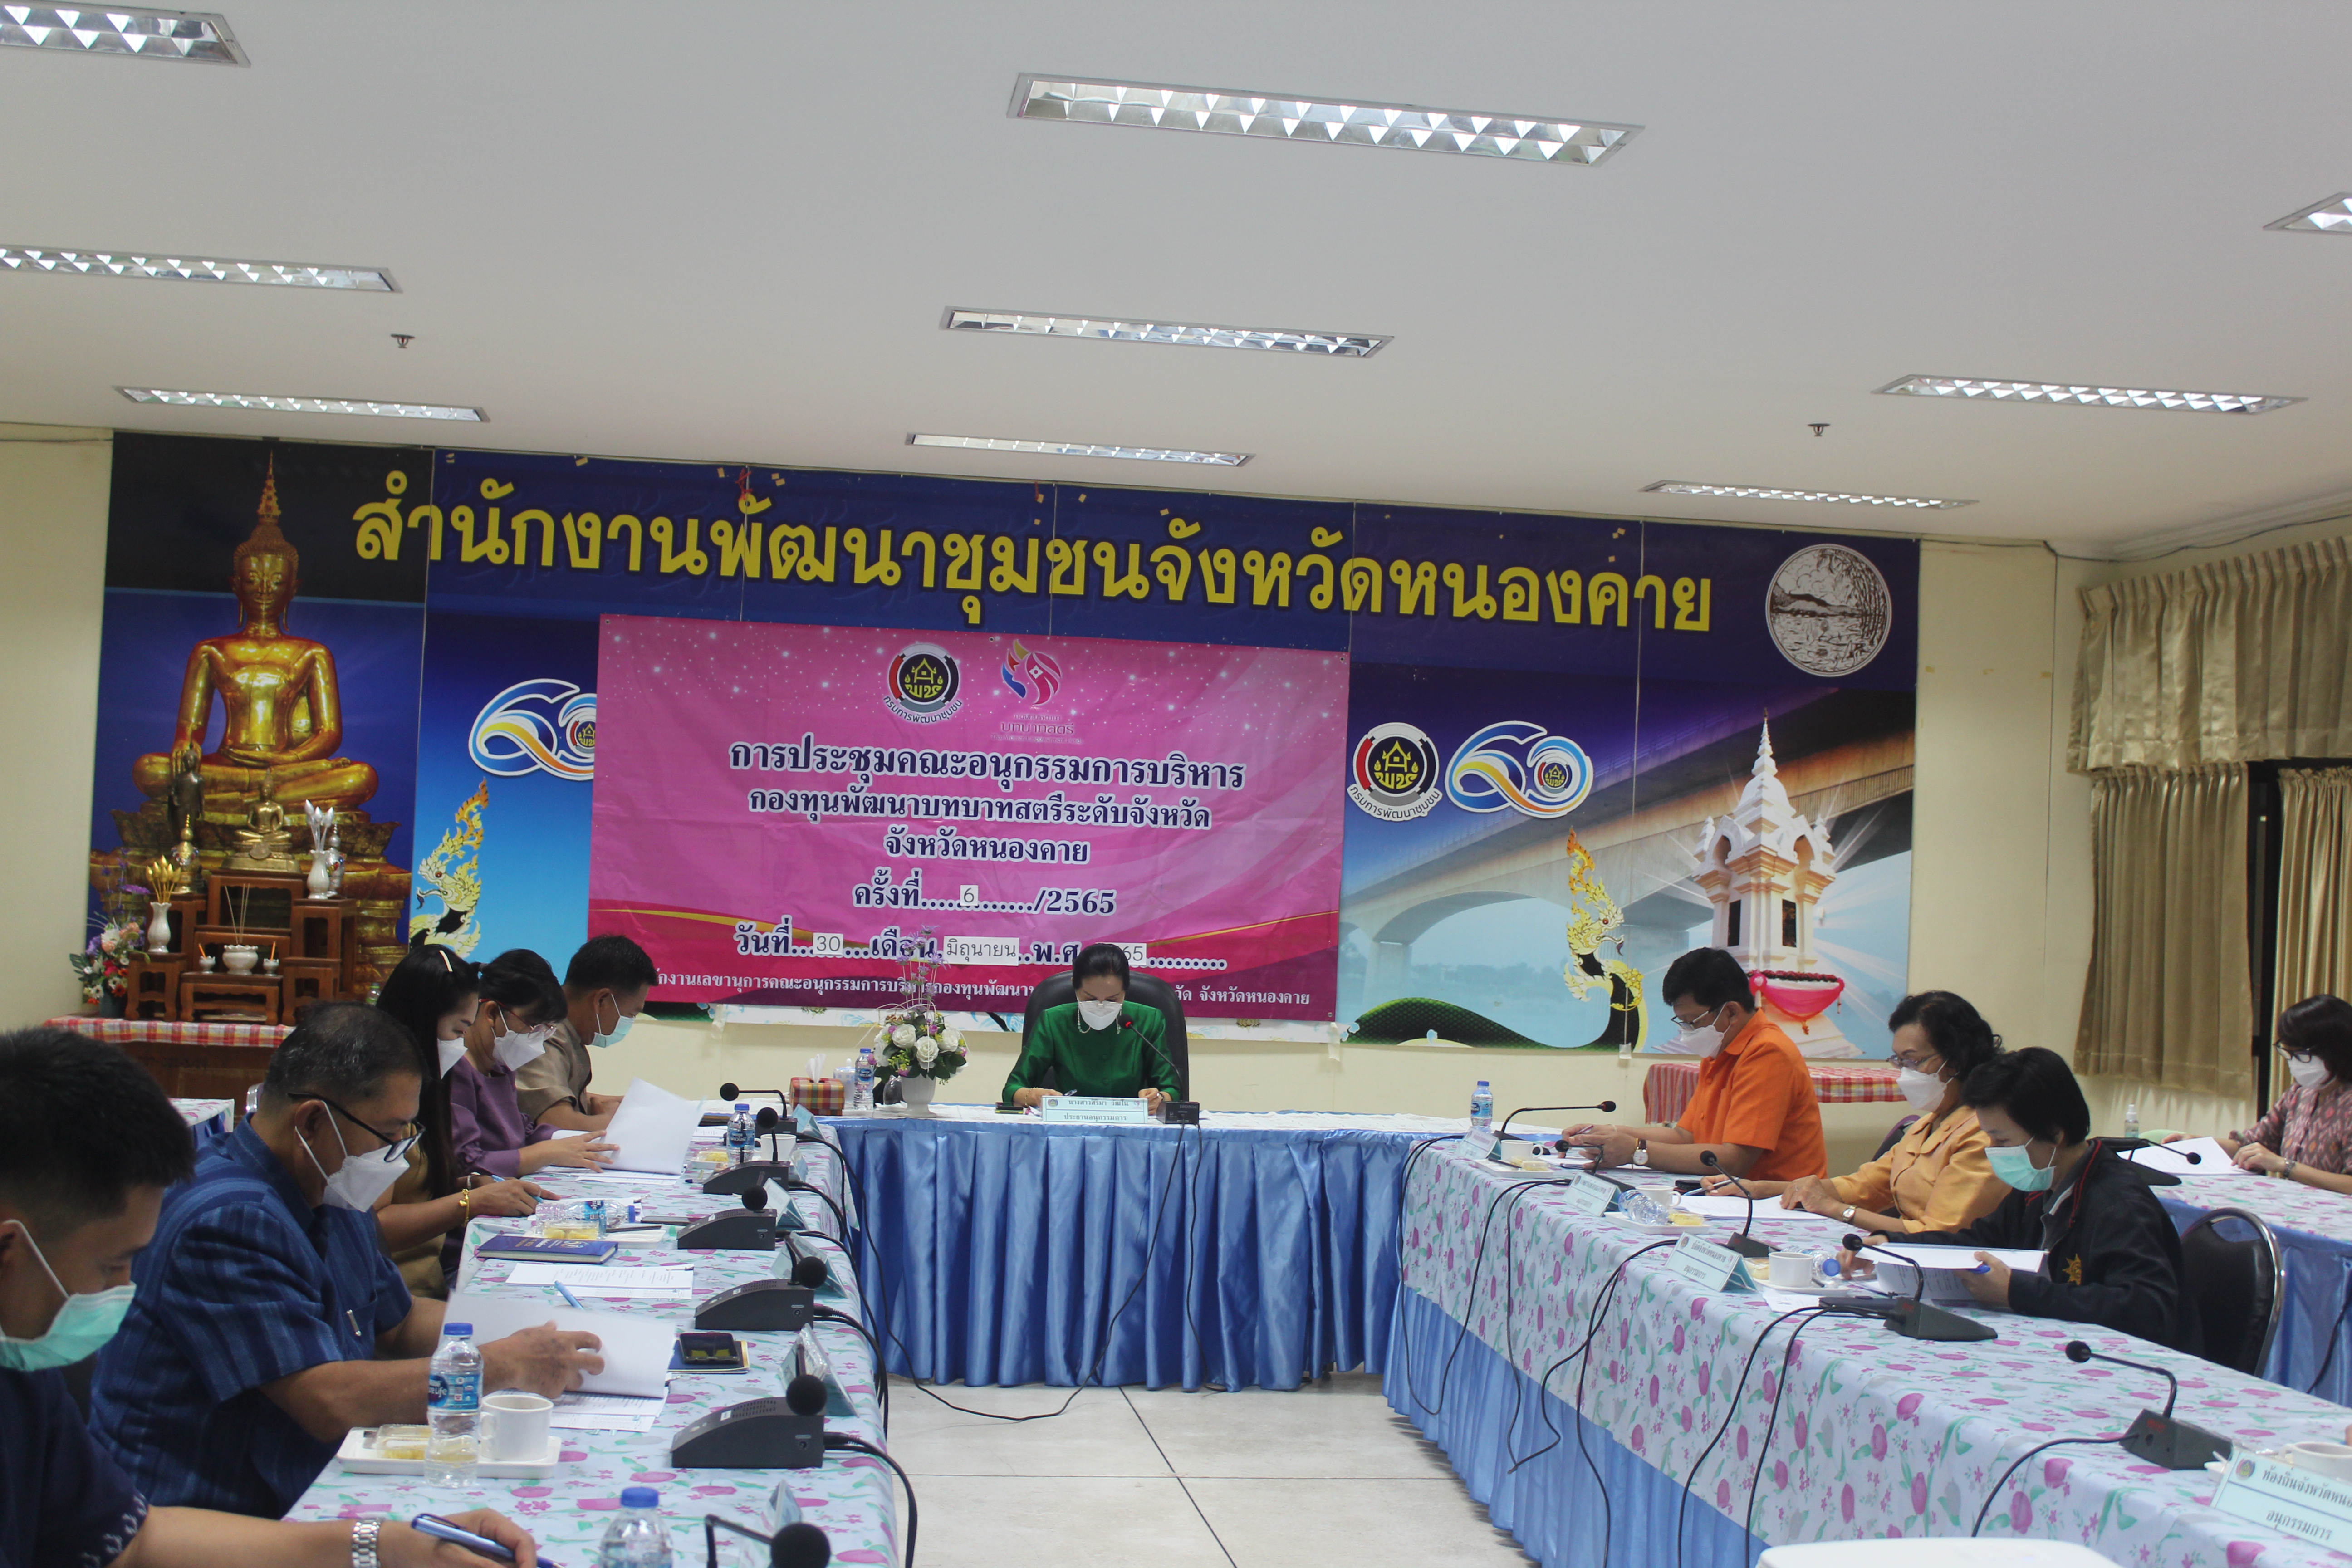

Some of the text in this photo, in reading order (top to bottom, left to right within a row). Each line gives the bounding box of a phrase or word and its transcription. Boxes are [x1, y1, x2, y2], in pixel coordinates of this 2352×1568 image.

[352, 470, 1711, 632] สำนักงานพัฒนาชุมชนจังหวัดหนองคาย
[883, 696, 962, 723] กรมการพัฒนาชุมชน
[1001, 723, 1074, 735] บทบาทสตรี
[731, 735, 1244, 791] การประชุมคณะอนุกรรมการบริหาร
[750, 786, 1210, 829] กองทุนพัฒนาบทบาทสตรีระดับจังหวัด
[1349, 786, 1441, 819] กรมการพัฒนาชุมชน
[885, 827, 1089, 863] จังหวัดหนองคาย
[947, 938, 1016, 962] มิถุนายน
[1199, 985, 1310, 1004] จังหวัดหนองคาย
[1064, 1113, 1127, 1122] ประธานอนุกรรมการ
